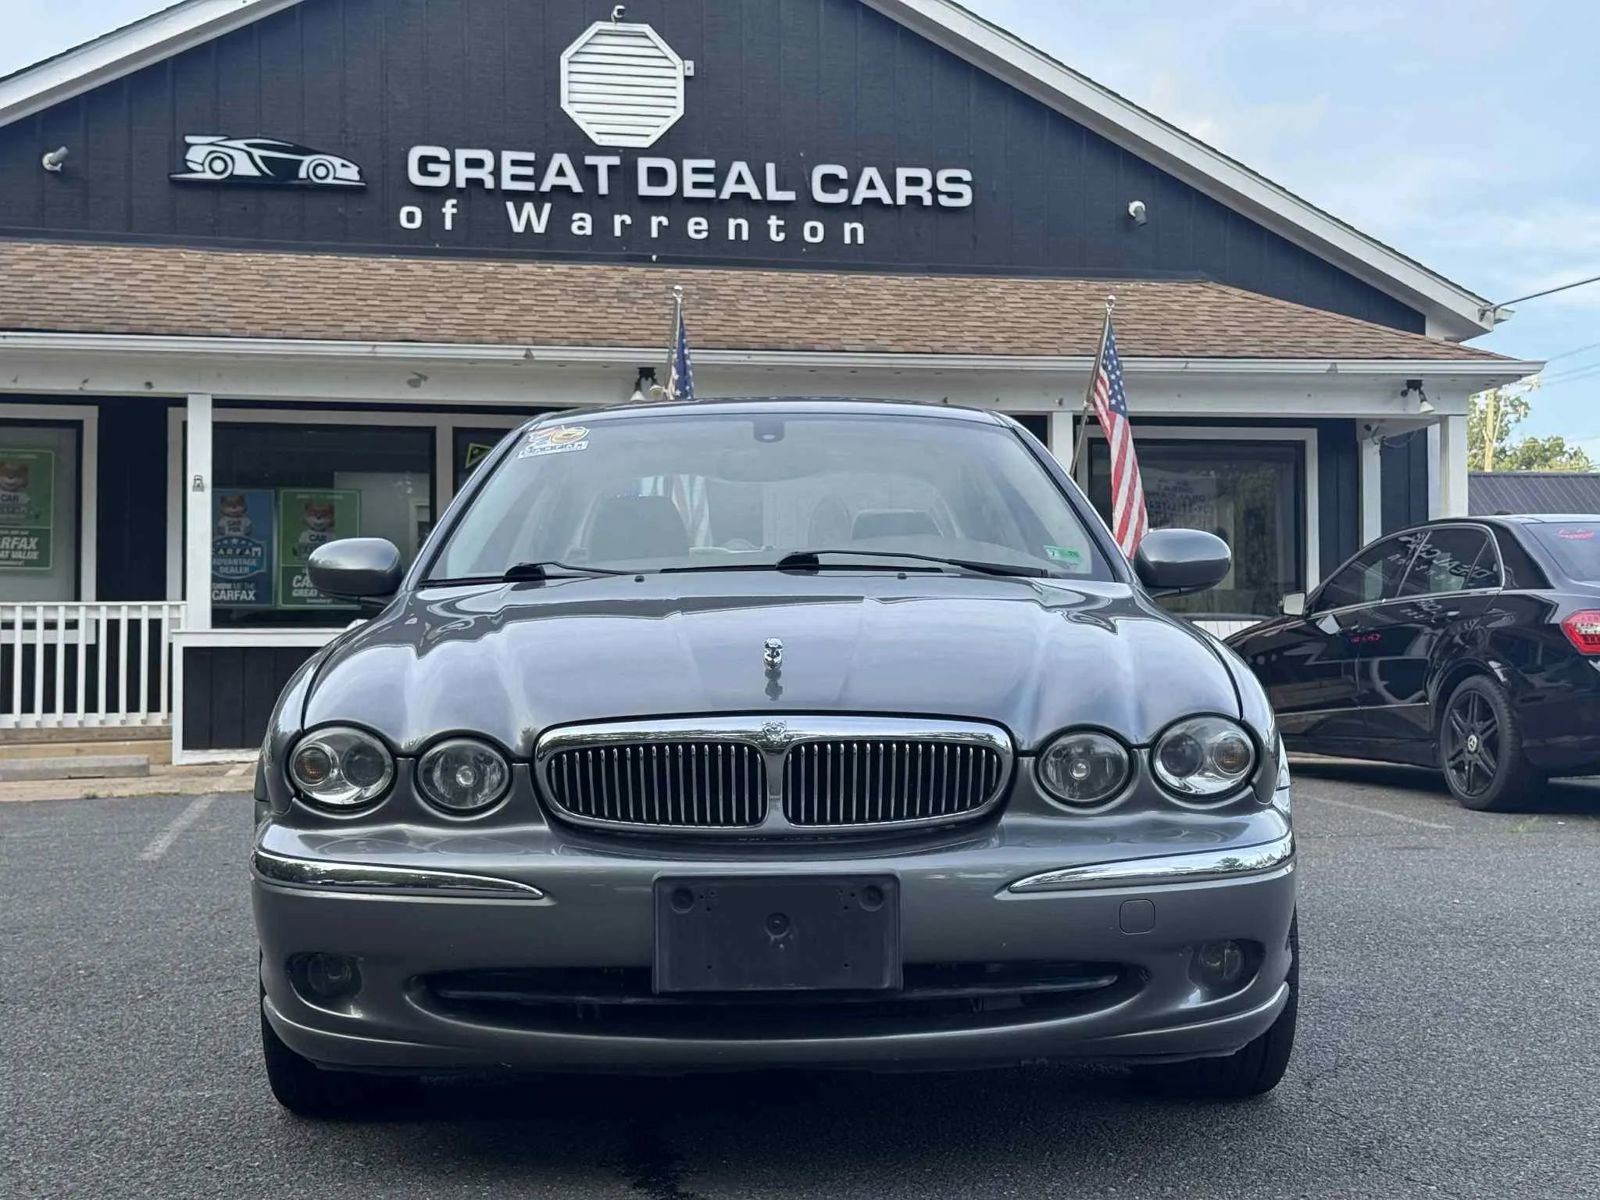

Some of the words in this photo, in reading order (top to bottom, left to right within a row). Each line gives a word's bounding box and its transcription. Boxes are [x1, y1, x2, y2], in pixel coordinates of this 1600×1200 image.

[408, 146, 621, 194] GREAT
[637, 158, 796, 201] DEAL
[811, 165, 973, 207] CARS
[399, 199, 458, 231] of
[505, 201, 865, 245] Warrenton
[0, 536, 39, 550] RFAX
[211, 590, 256, 601] CARFAX
